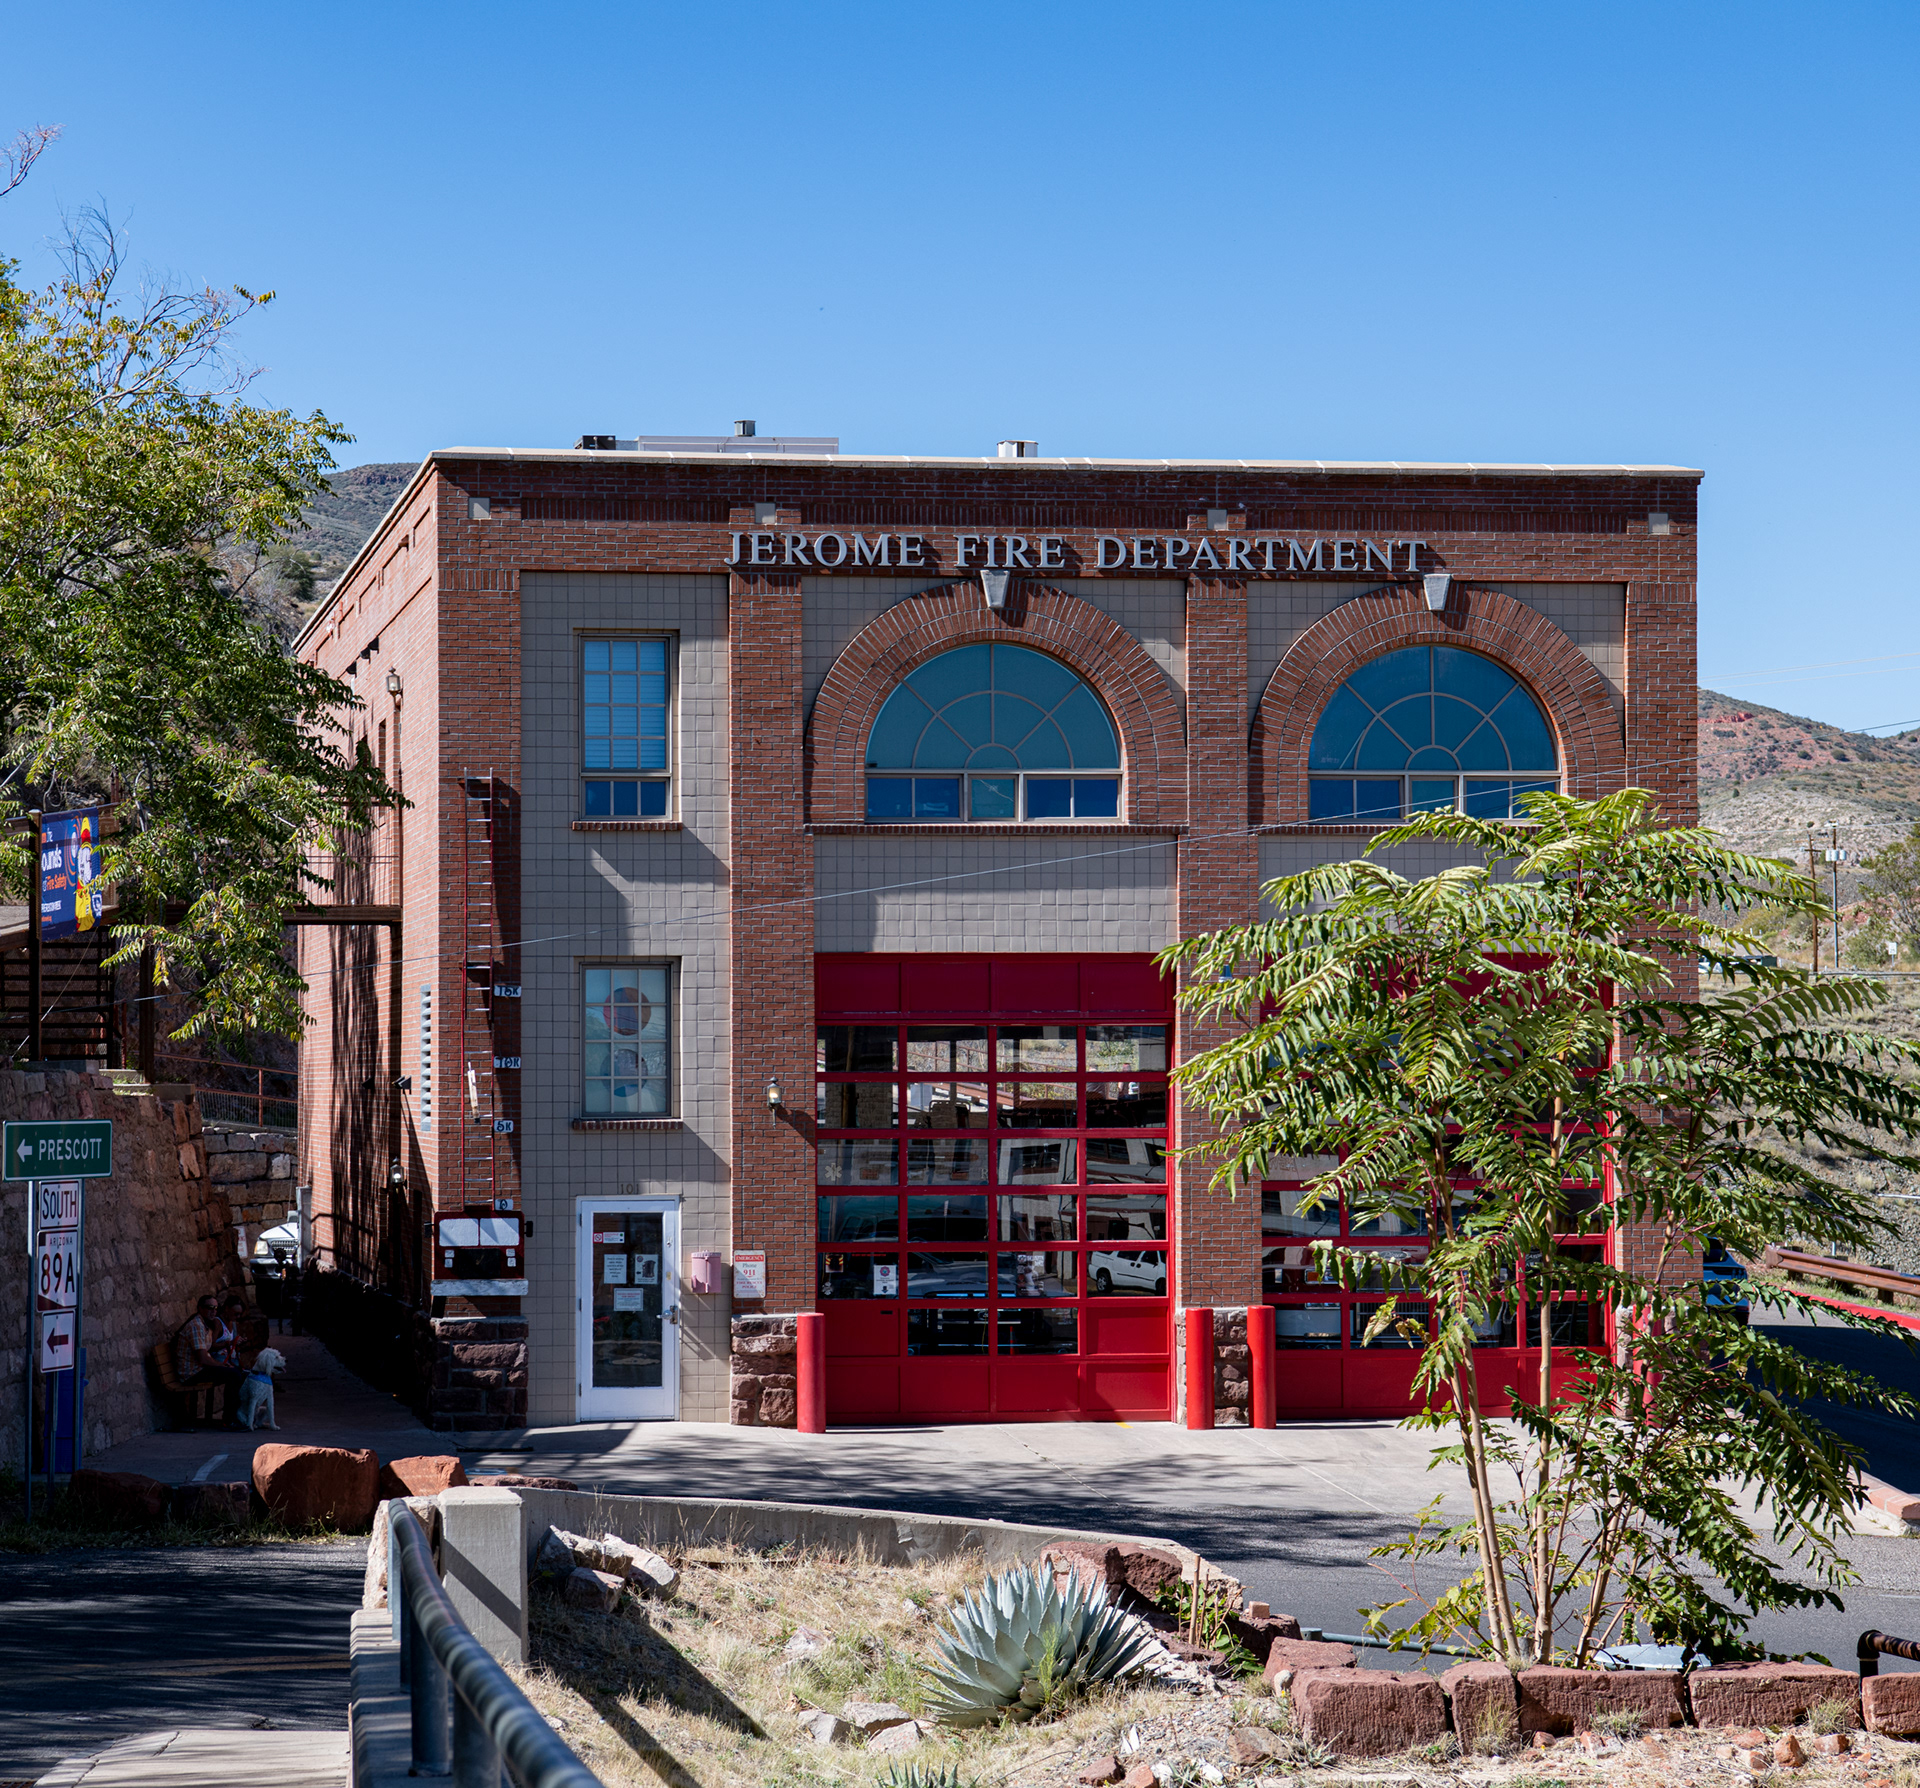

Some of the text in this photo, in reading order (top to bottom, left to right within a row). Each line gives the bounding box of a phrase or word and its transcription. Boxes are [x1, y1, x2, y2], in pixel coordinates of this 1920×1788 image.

[723, 532, 1428, 572] JEROME FIRE DEPARTMENT
[41, 843, 62, 872] ounds
[496, 1120, 512, 1132] 5K
[38, 1138, 103, 1161] PRESCOTT
[620, 1183, 640, 1195] 101
[42, 1188, 77, 1220] SOUTH
[49, 1236, 73, 1247] ARIZONA
[40, 1252, 75, 1296] 89A
